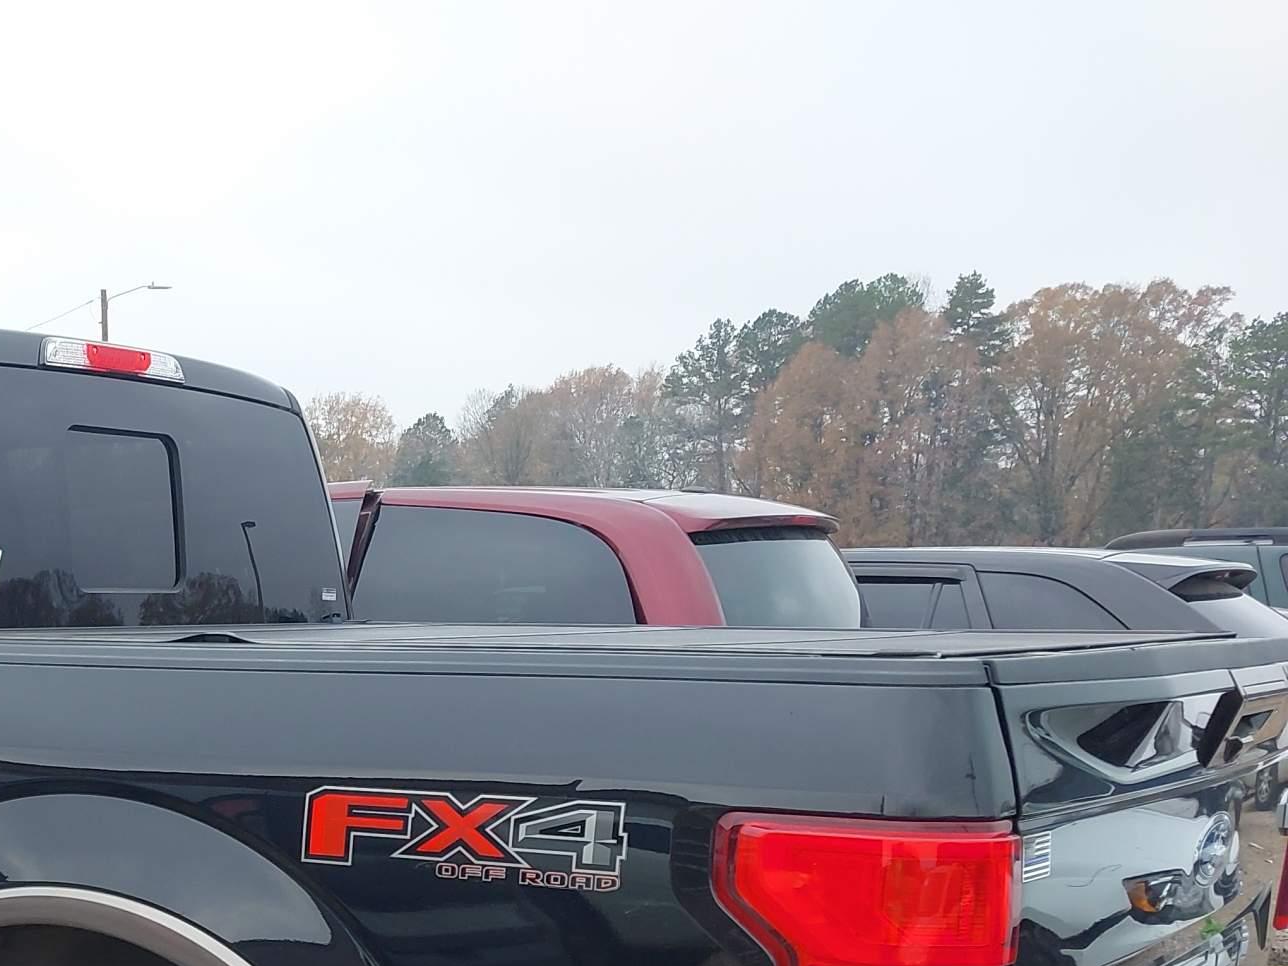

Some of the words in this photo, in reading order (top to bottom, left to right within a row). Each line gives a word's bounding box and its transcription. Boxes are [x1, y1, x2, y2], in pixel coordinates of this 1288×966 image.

[302, 787, 626, 873] FX4
[435, 863, 506, 882] OFF
[519, 868, 620, 892] ROAD
